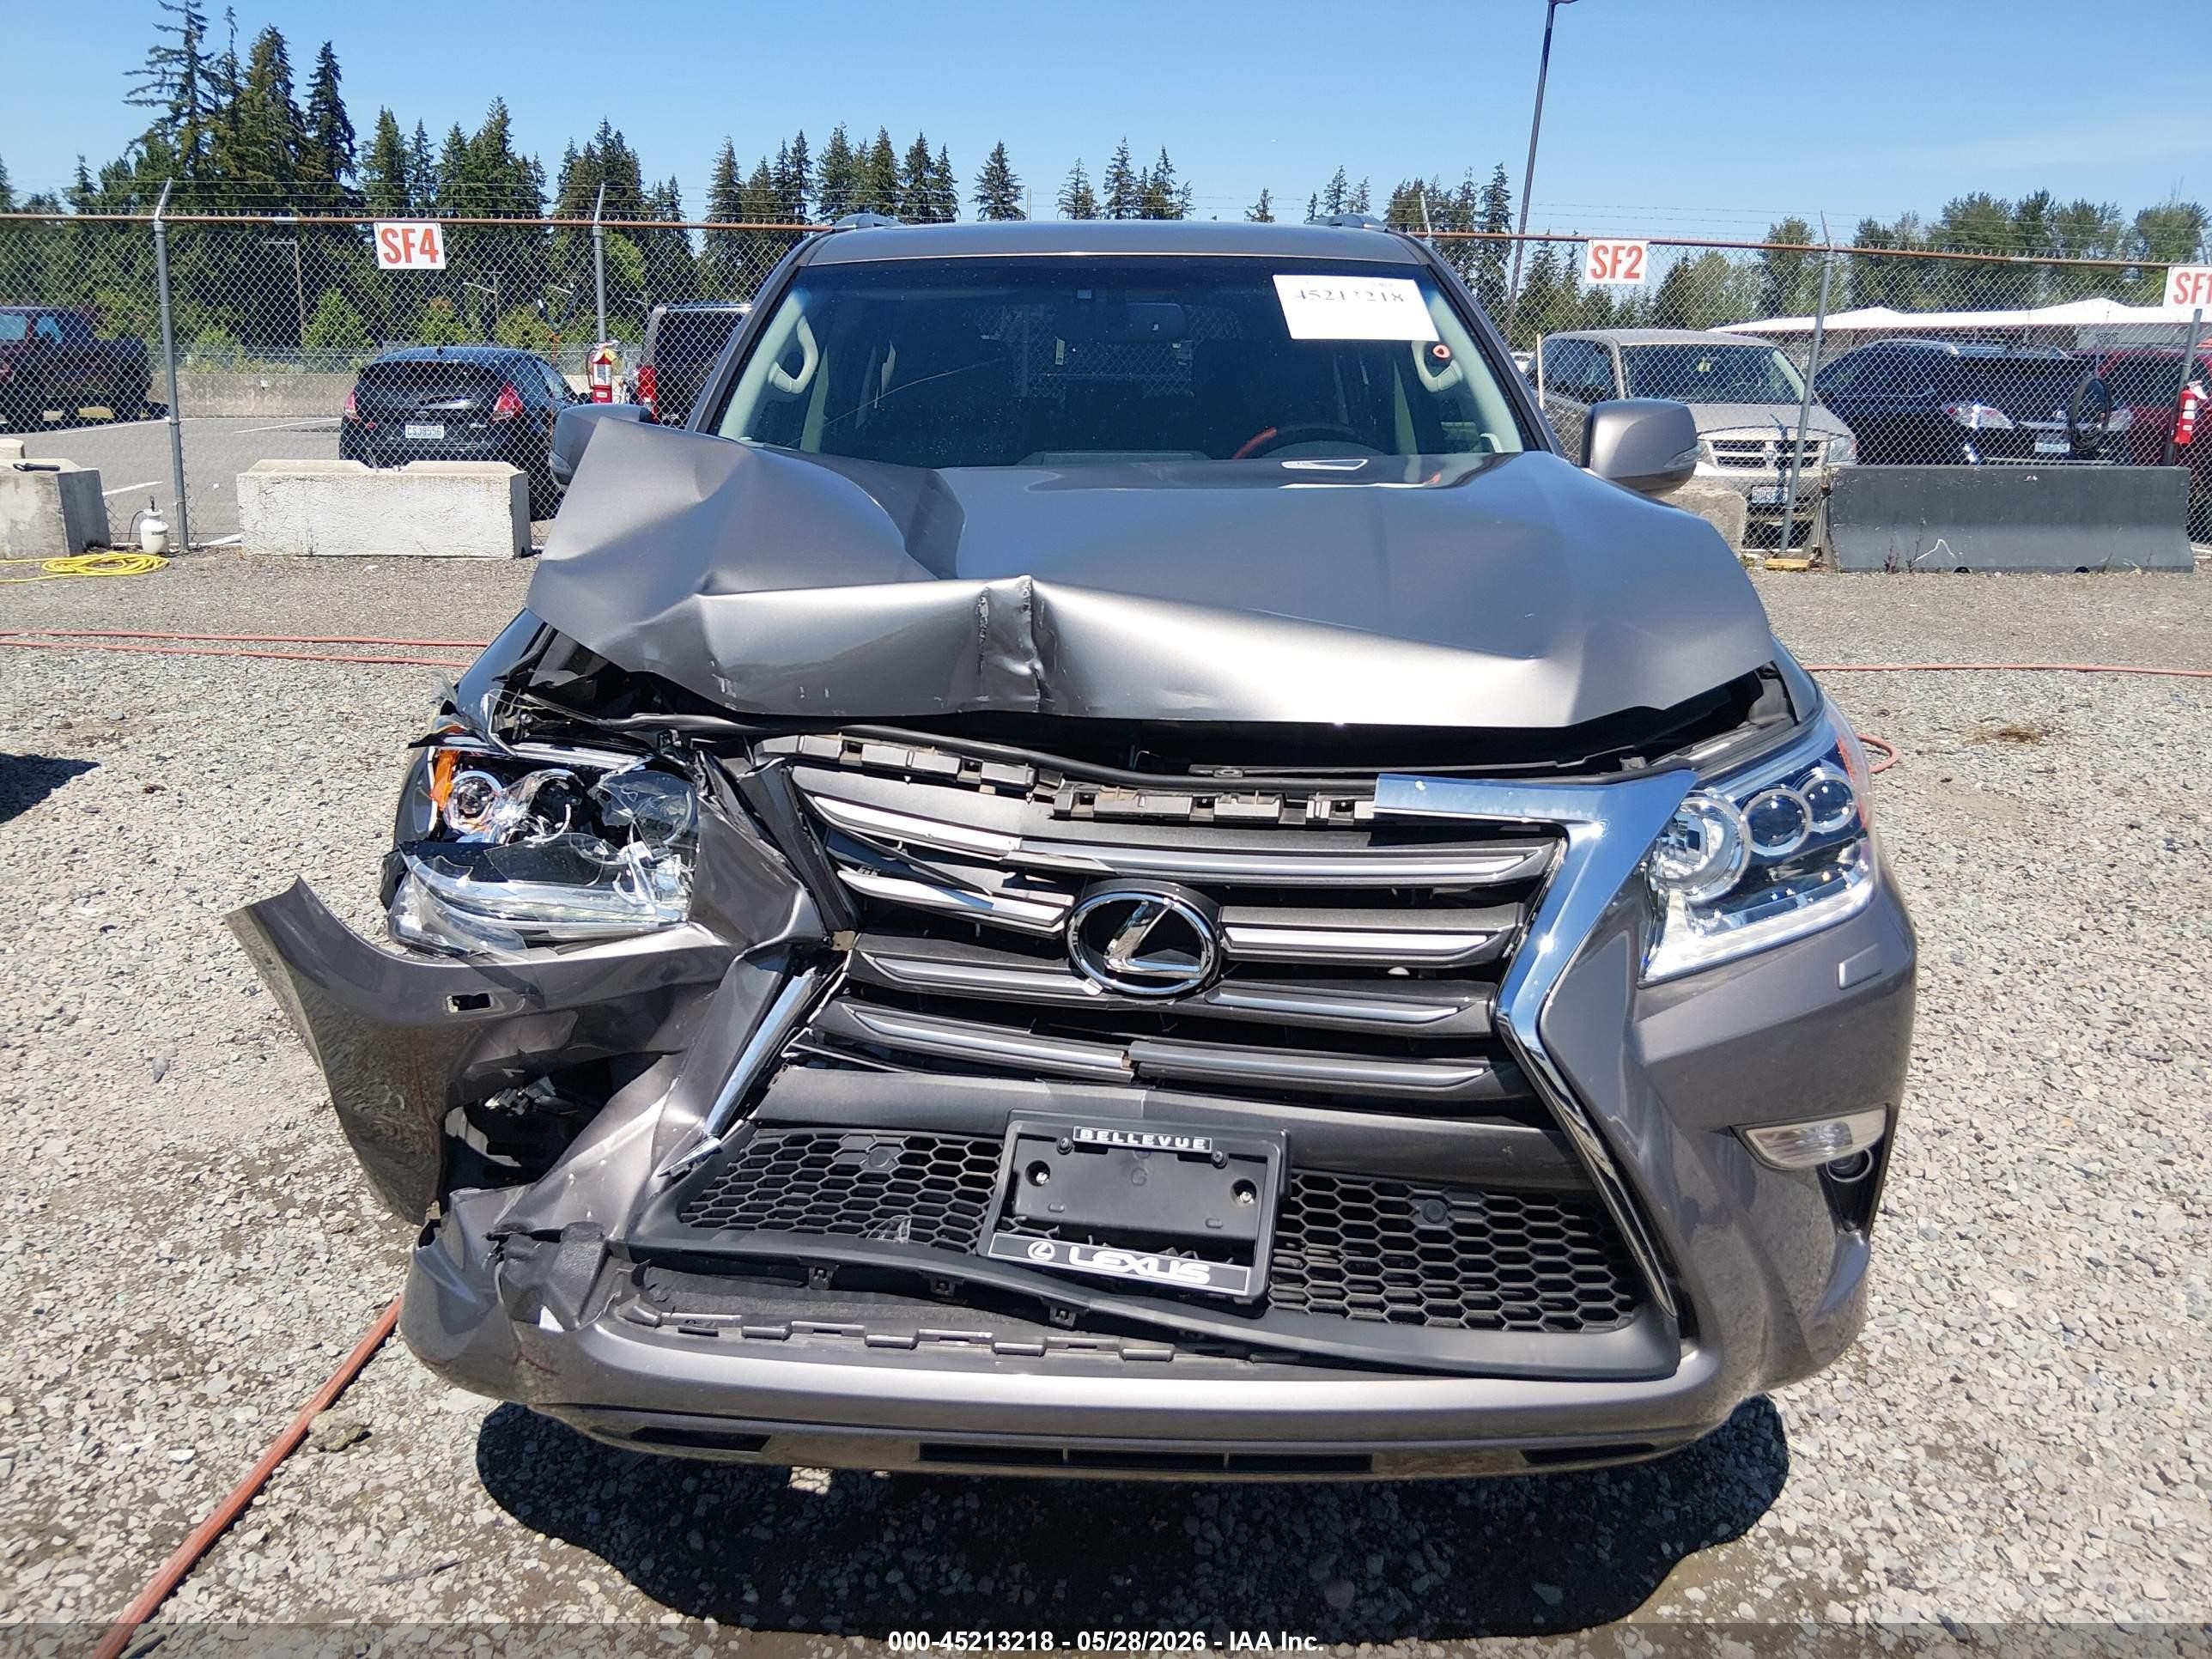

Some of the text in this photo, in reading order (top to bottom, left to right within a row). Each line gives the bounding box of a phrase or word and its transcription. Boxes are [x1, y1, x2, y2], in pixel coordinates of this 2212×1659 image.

[380, 228, 440, 264] SF4
[1589, 244, 1644, 279] SF2
[1079, 1128, 1206, 1150] BELLEVUE
[1068, 1246, 1211, 1285] LEXUS
